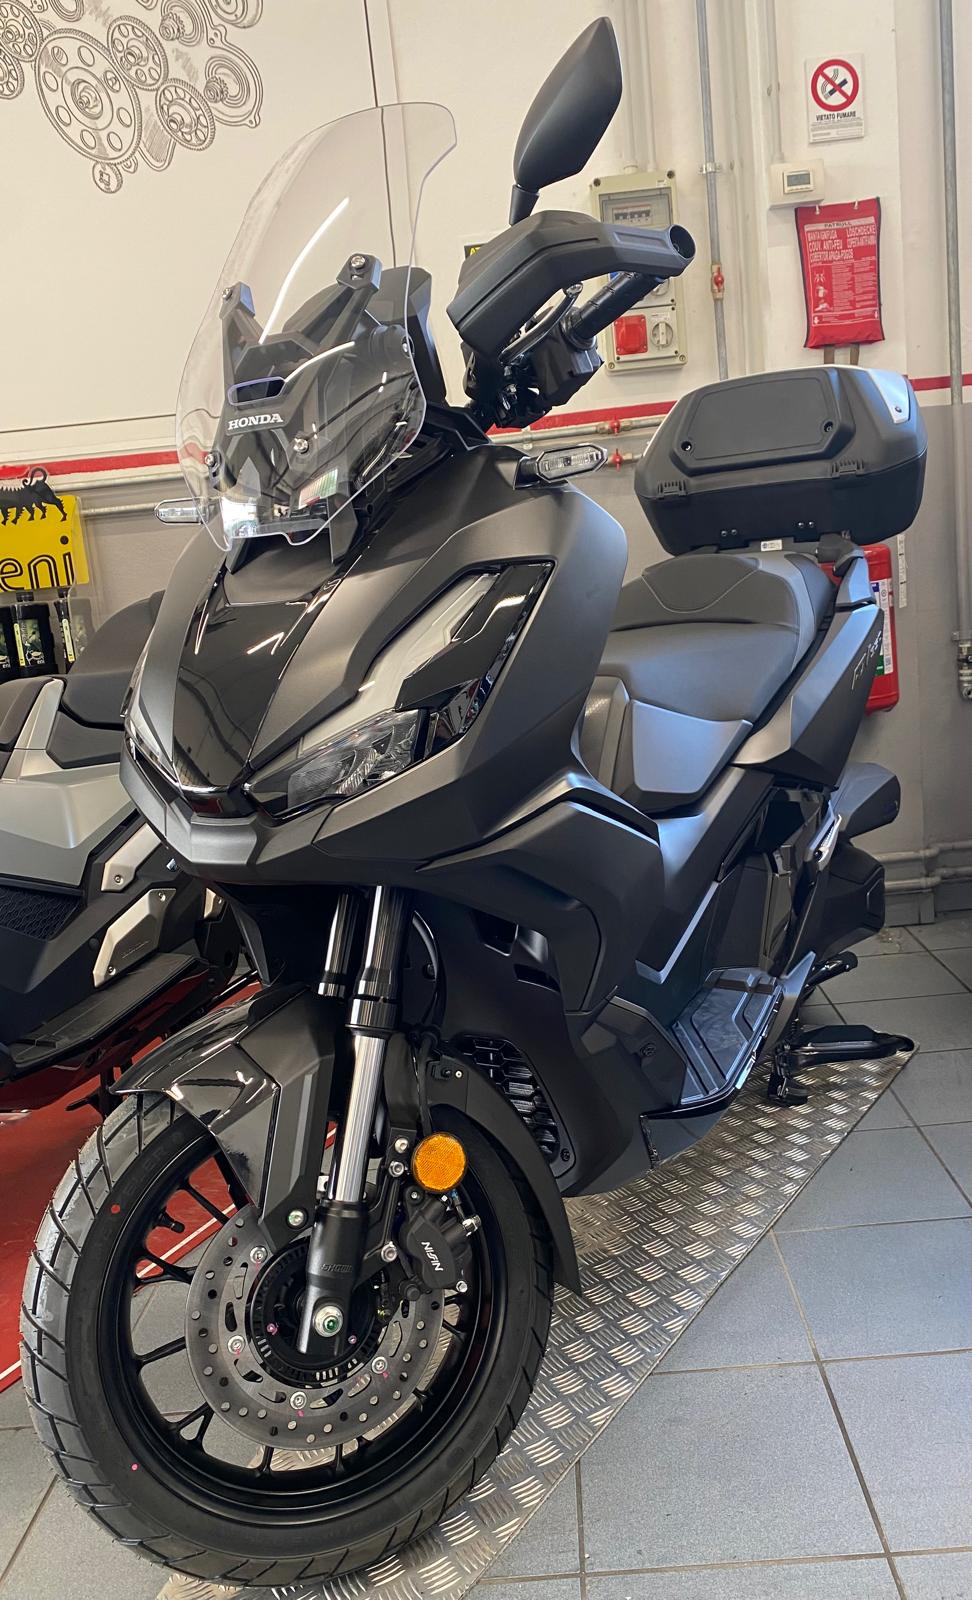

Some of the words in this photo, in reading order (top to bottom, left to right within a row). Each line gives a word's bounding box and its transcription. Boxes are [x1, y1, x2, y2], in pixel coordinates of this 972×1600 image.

[836, 111, 856, 119] FUMARE
[227, 413, 284, 430] HONDA
[0, 535, 75, 592] eni
[421, 1241, 444, 1271] NISSIN
